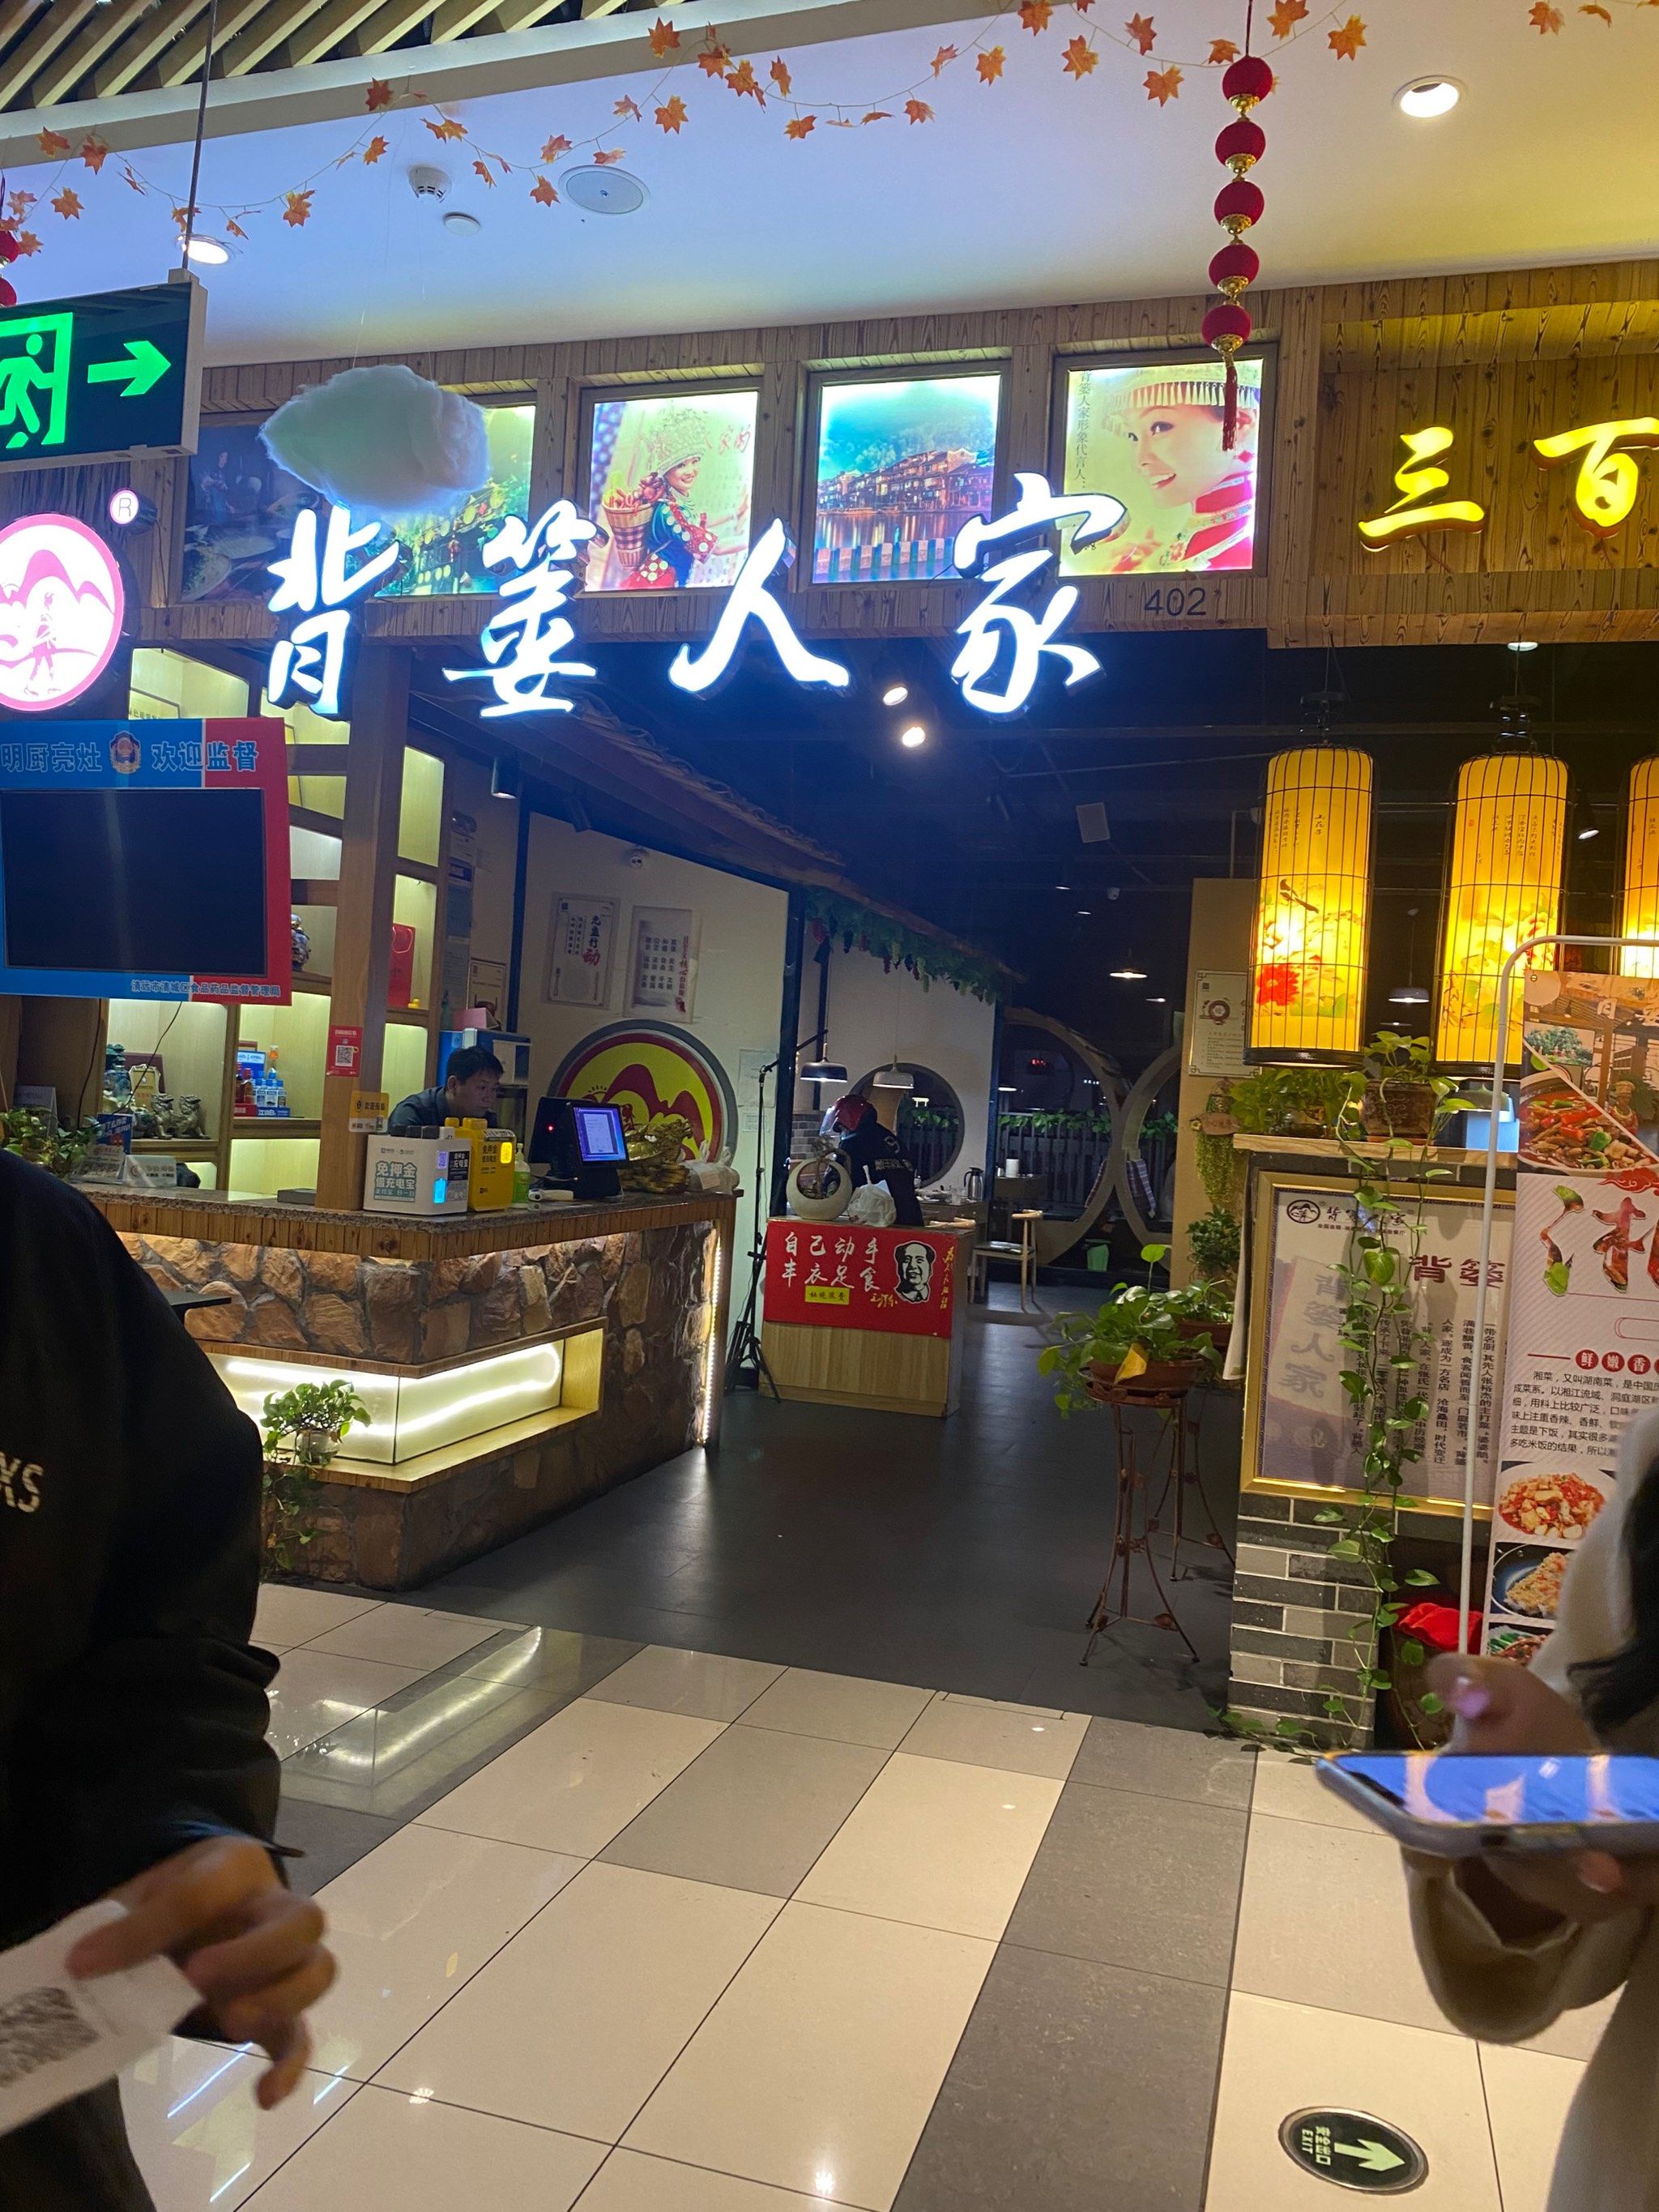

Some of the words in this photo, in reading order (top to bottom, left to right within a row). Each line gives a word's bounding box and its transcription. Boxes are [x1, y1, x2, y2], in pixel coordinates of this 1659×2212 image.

[266, 472, 1127, 720] 背篓人家
[1143, 586, 1208, 617] 402
[0, 741, 103, 773] 明厨亮灶
[151, 740, 259, 772] 欢迎监督
[130, 978, 282, 999] 清远市清城区食品药品监督管理局
[375, 1160, 416, 1178] 免押金
[784, 1231, 879, 1265] 自己动手
[782, 1258, 881, 1293] 丰衣足食
[1301, 2129, 1314, 2155] EXIT
[1315, 2126, 1332, 2166] 安全出口
